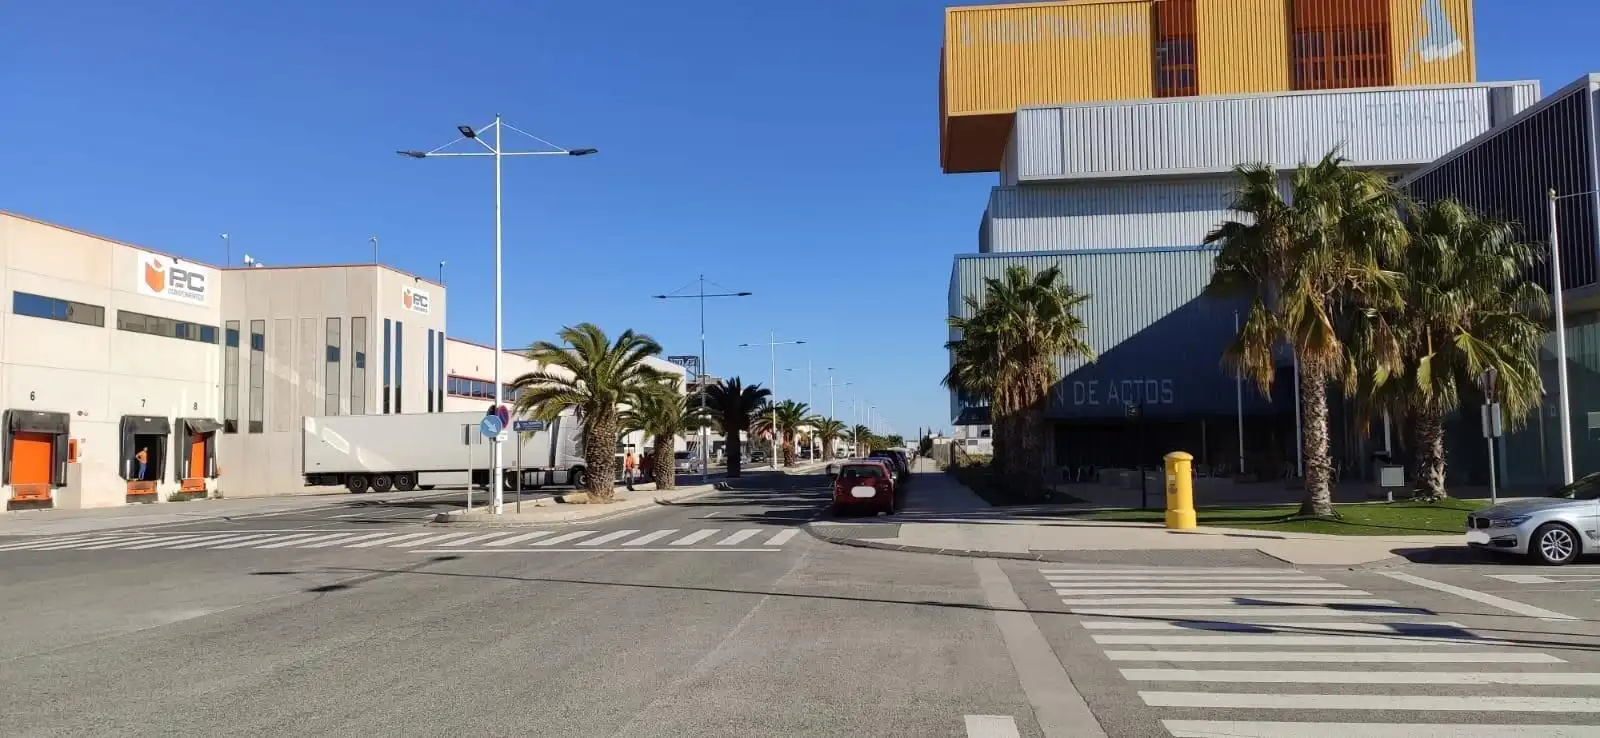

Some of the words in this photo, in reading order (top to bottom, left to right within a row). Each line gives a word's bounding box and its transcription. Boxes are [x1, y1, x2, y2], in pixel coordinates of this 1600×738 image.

[30, 391, 35, 401] 6
[1073, 380, 1099, 405] DE
[1107, 379, 1173, 405] ACTOS
[141, 399, 146, 408] 7
[193, 403, 198, 411] 8
